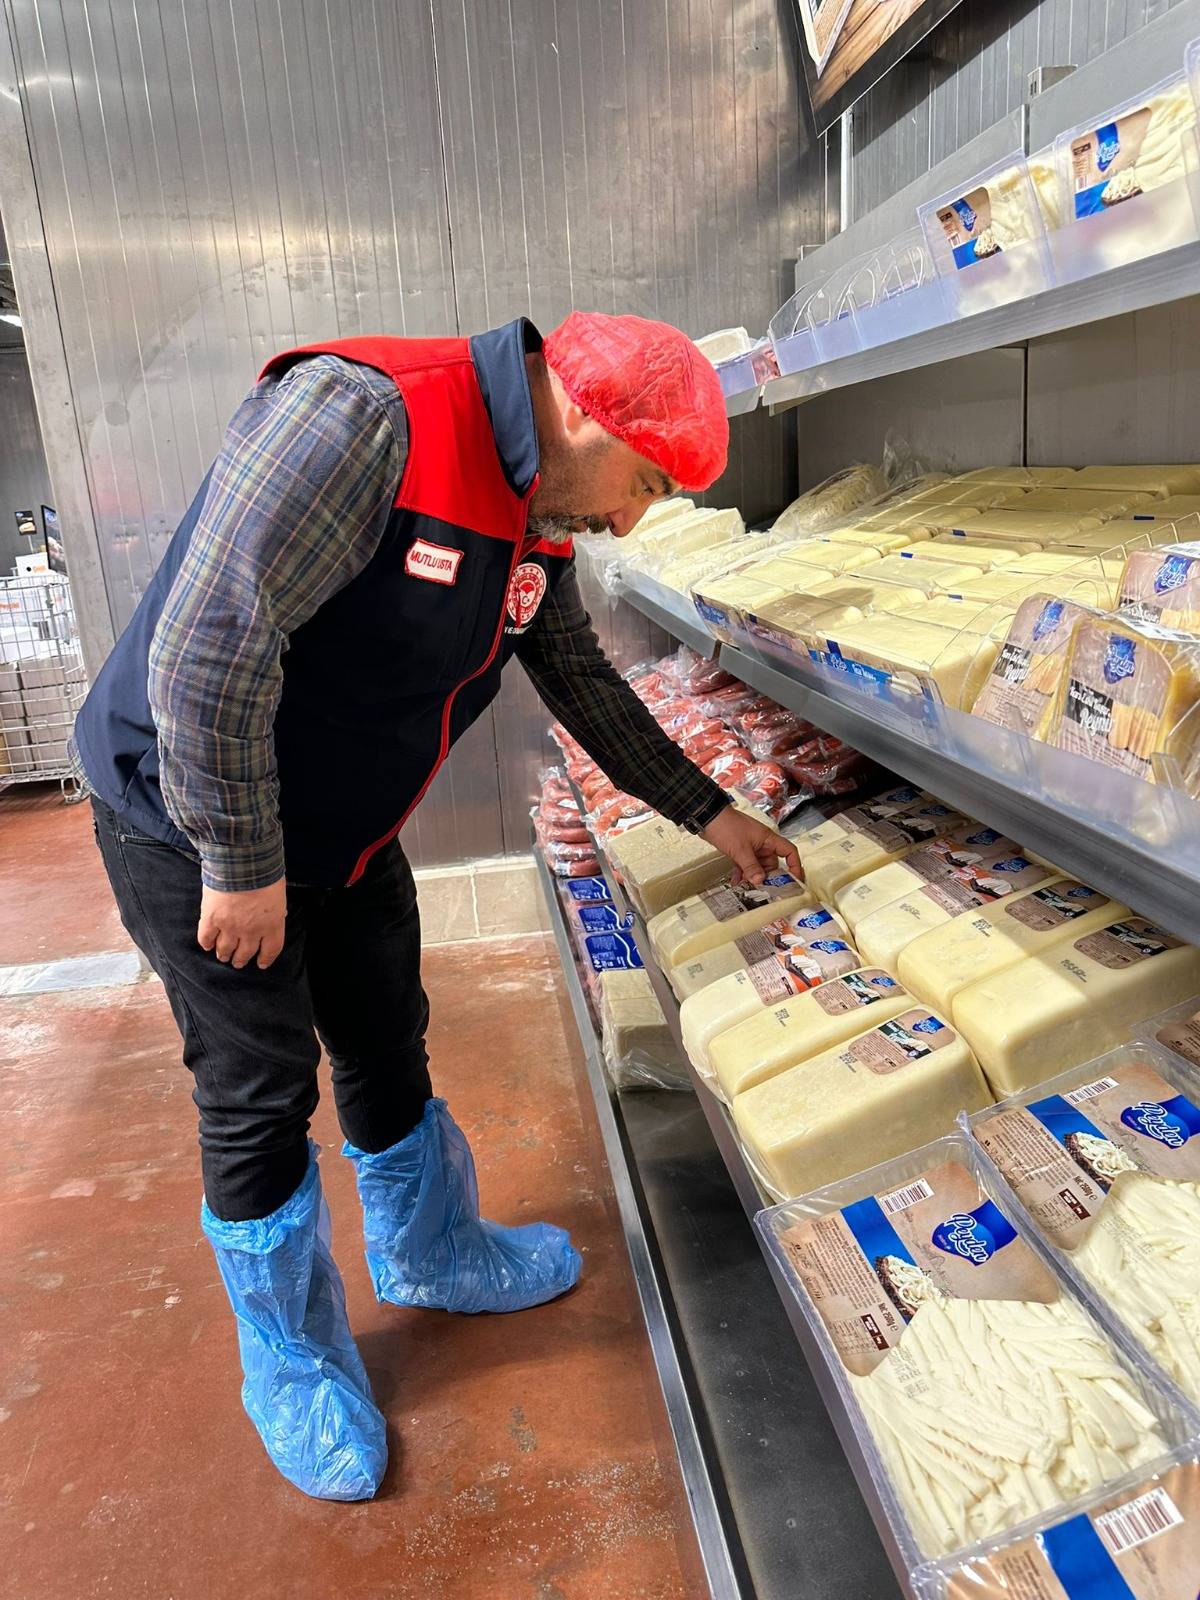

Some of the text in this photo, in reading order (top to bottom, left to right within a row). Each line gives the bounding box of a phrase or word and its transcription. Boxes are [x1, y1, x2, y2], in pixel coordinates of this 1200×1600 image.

[410, 550, 437, 568] MUTLU
[1131, 1101, 1184, 1147] Peyden
[943, 1212, 989, 1262] Peyden
